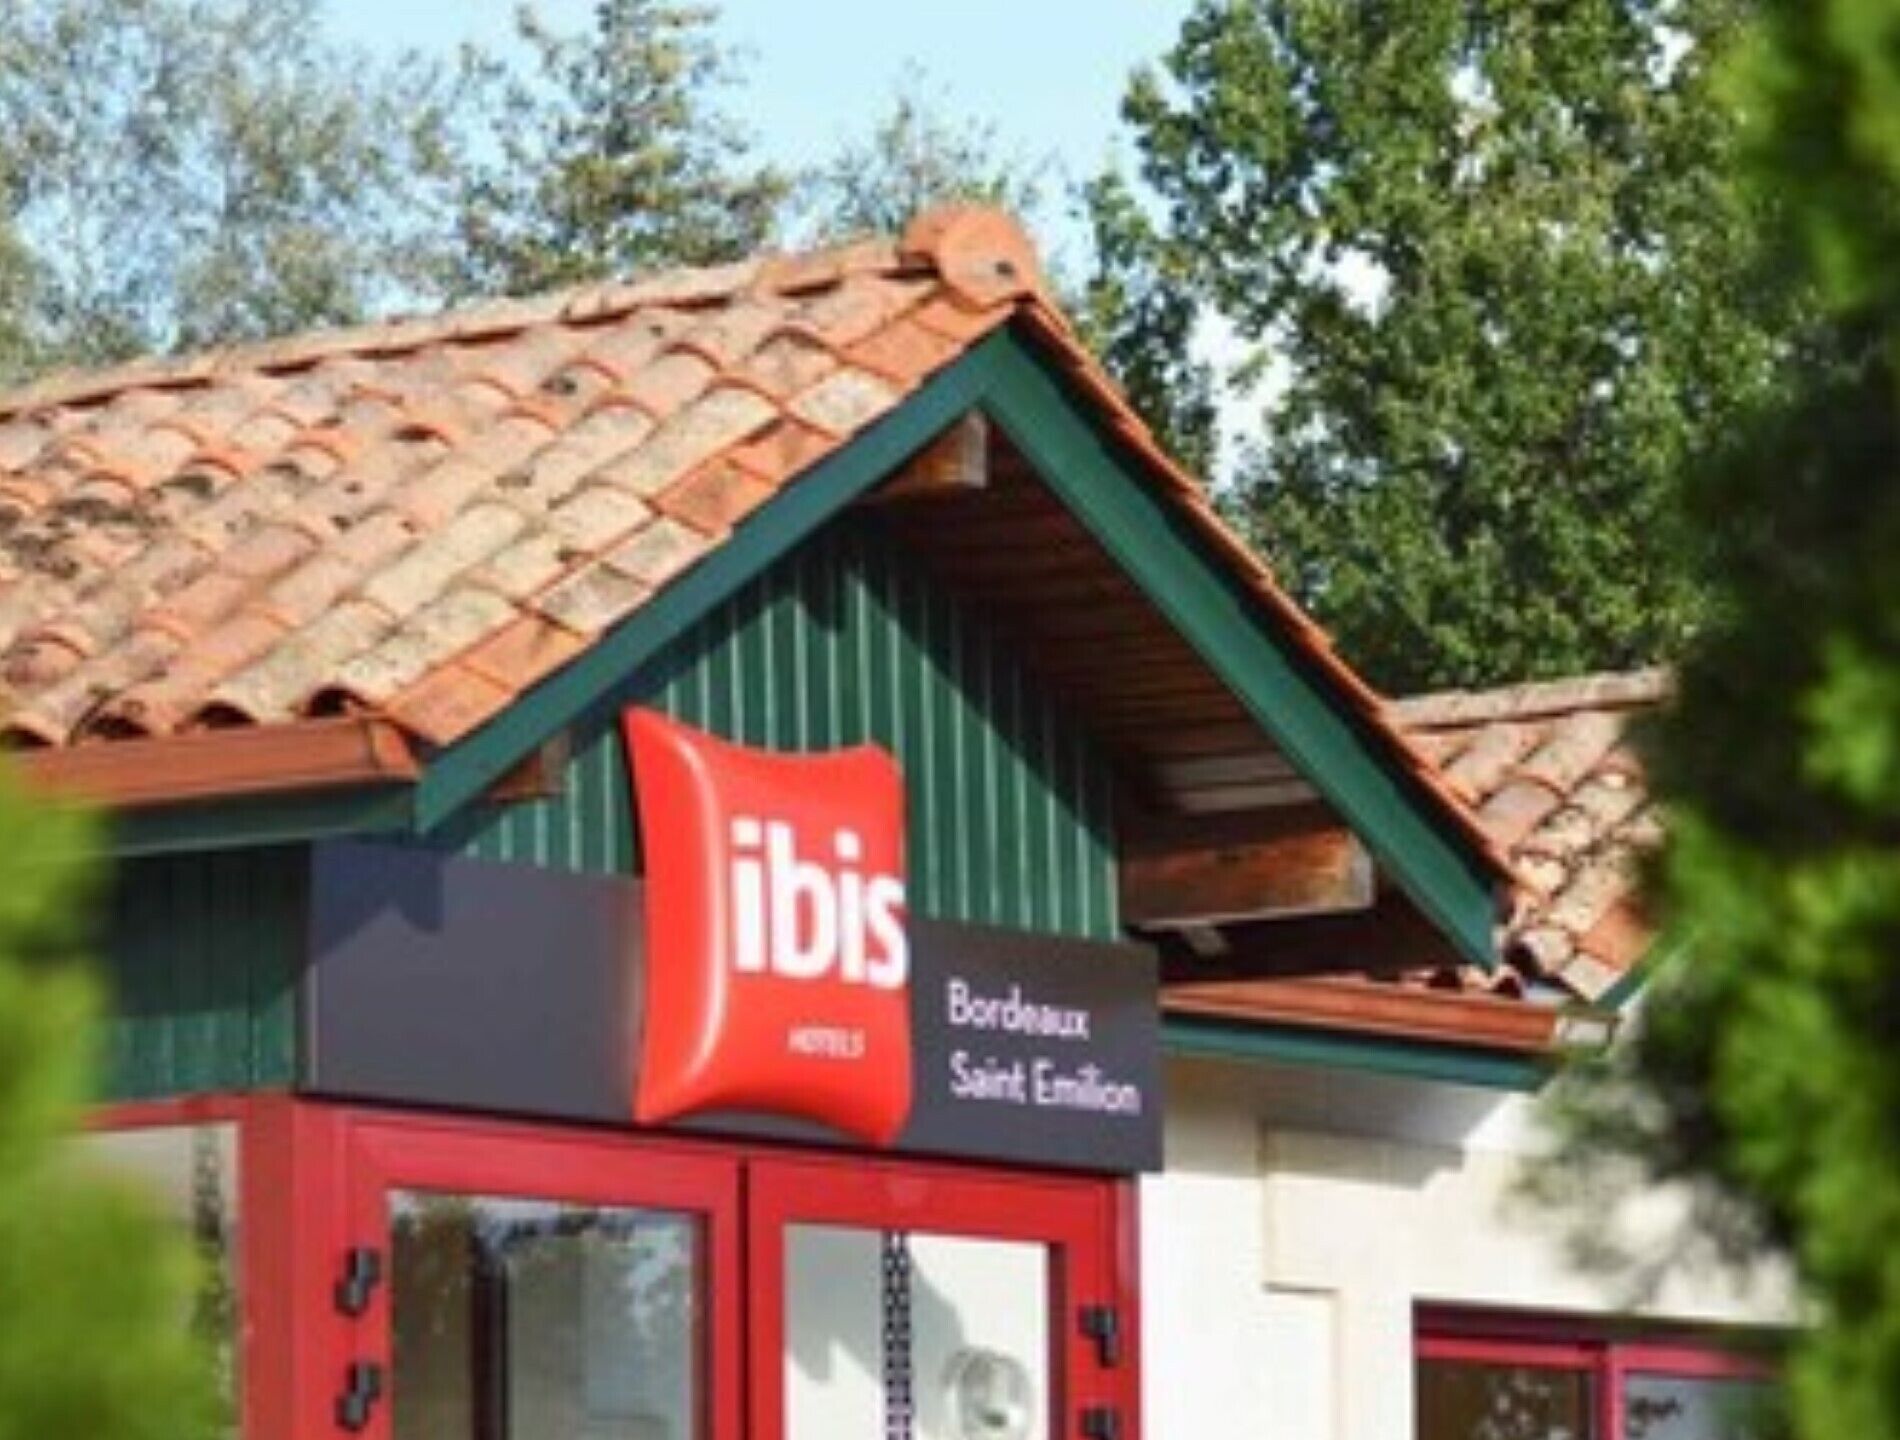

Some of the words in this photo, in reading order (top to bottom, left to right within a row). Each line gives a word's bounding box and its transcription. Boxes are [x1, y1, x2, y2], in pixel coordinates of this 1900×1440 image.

[730, 817, 910, 989] ibis
[948, 977, 1090, 1040] Bordeaux
[787, 1026, 866, 1059] HOTELS
[950, 1050, 1026, 1104] Saint
[1032, 1057, 1143, 1117] Emilion
